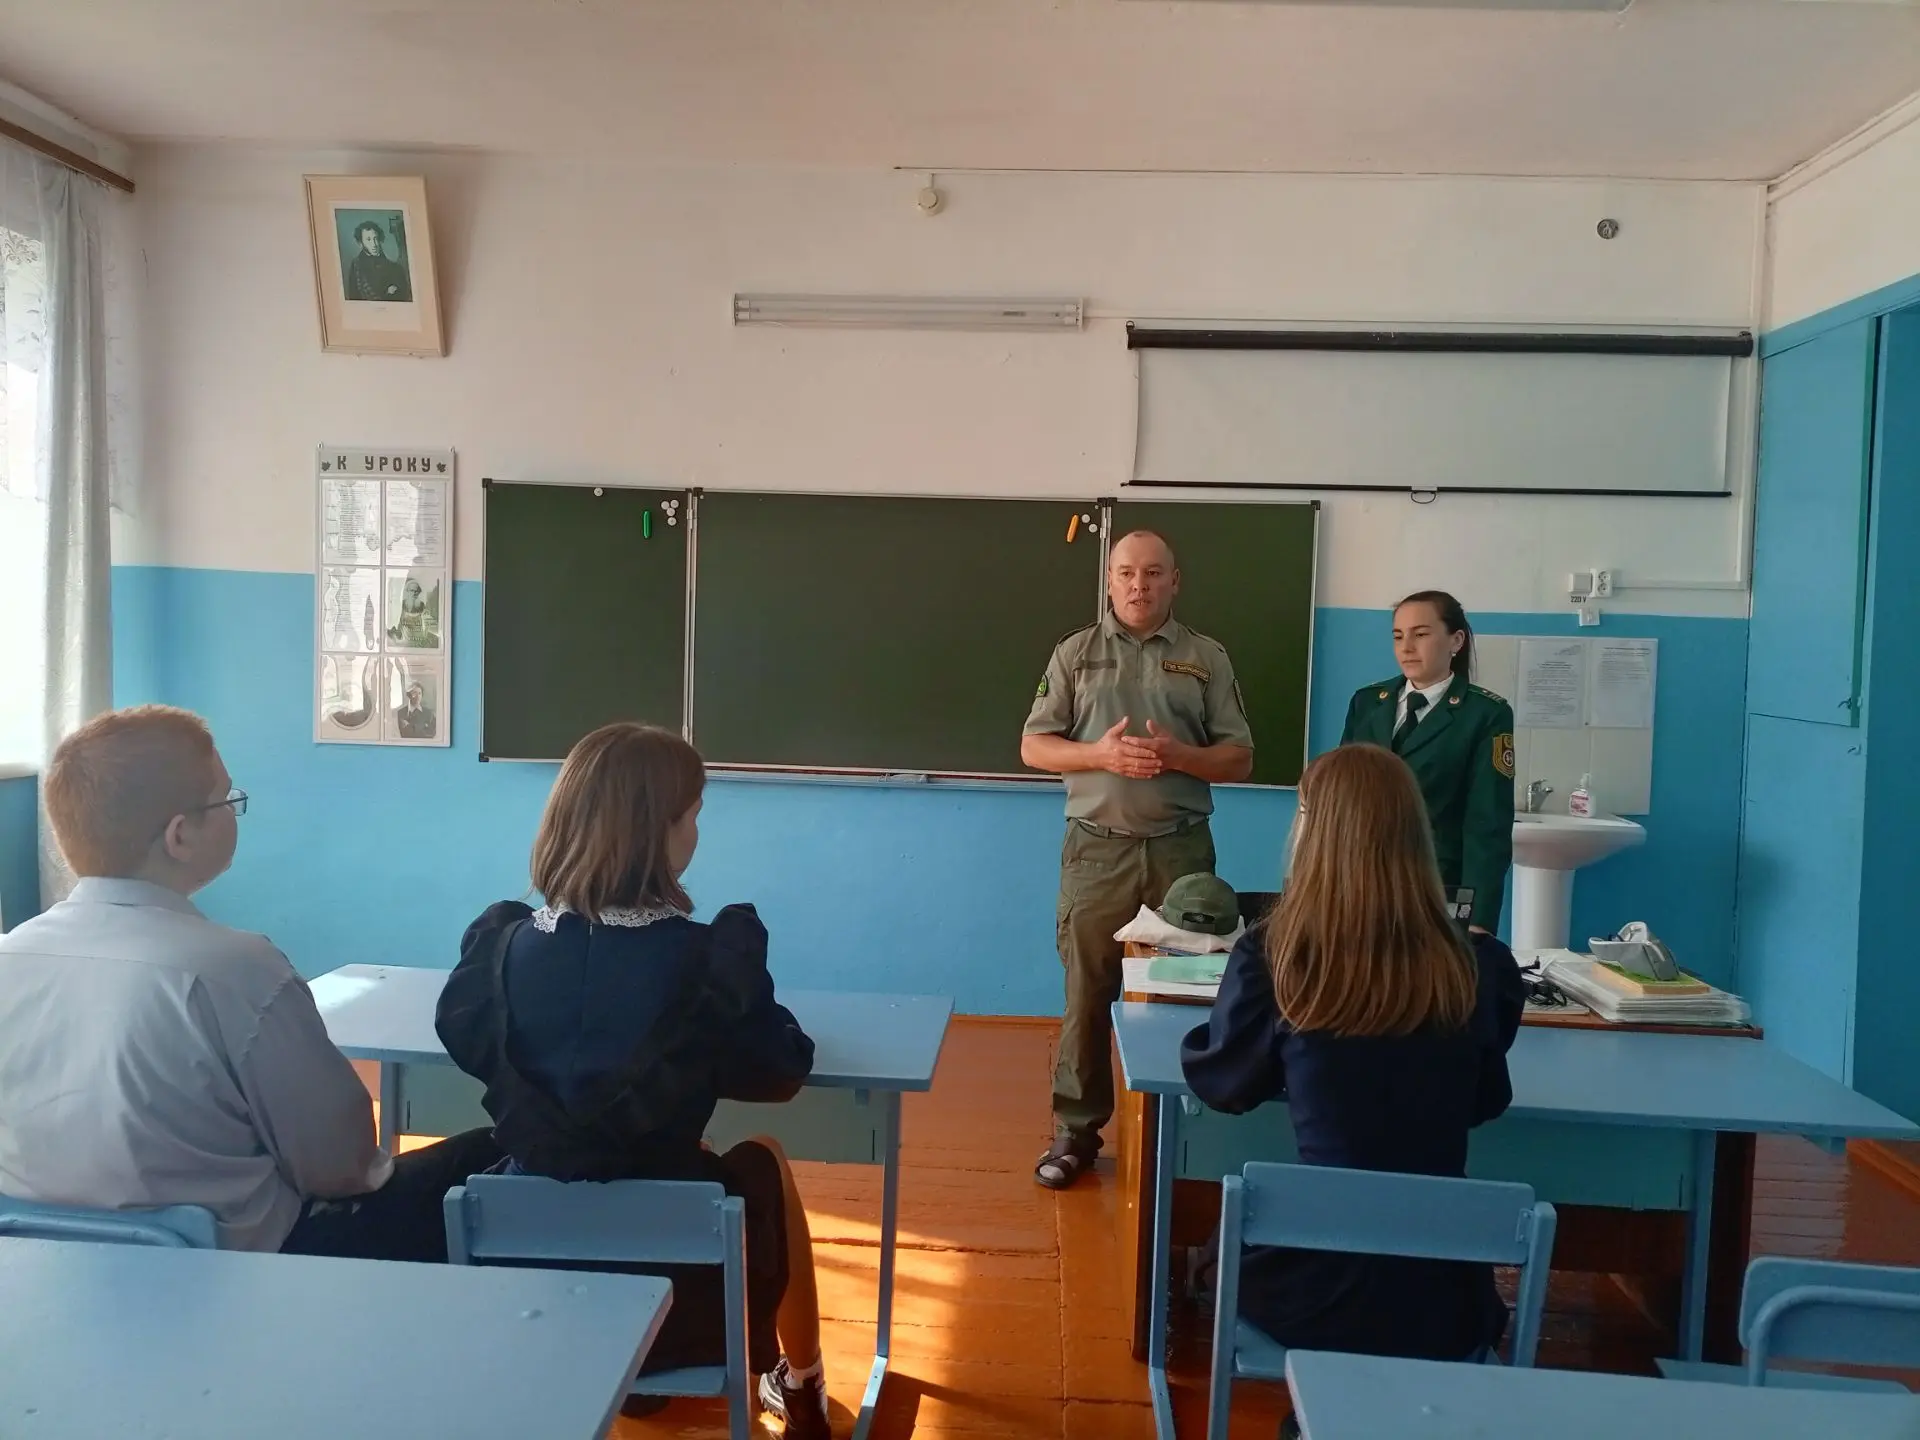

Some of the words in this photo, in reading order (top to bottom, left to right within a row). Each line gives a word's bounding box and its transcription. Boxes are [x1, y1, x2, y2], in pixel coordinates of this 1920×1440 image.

[337, 455, 347, 470] К
[364, 455, 431, 473] УРОКУ
[1570, 595, 1581, 603] 220
